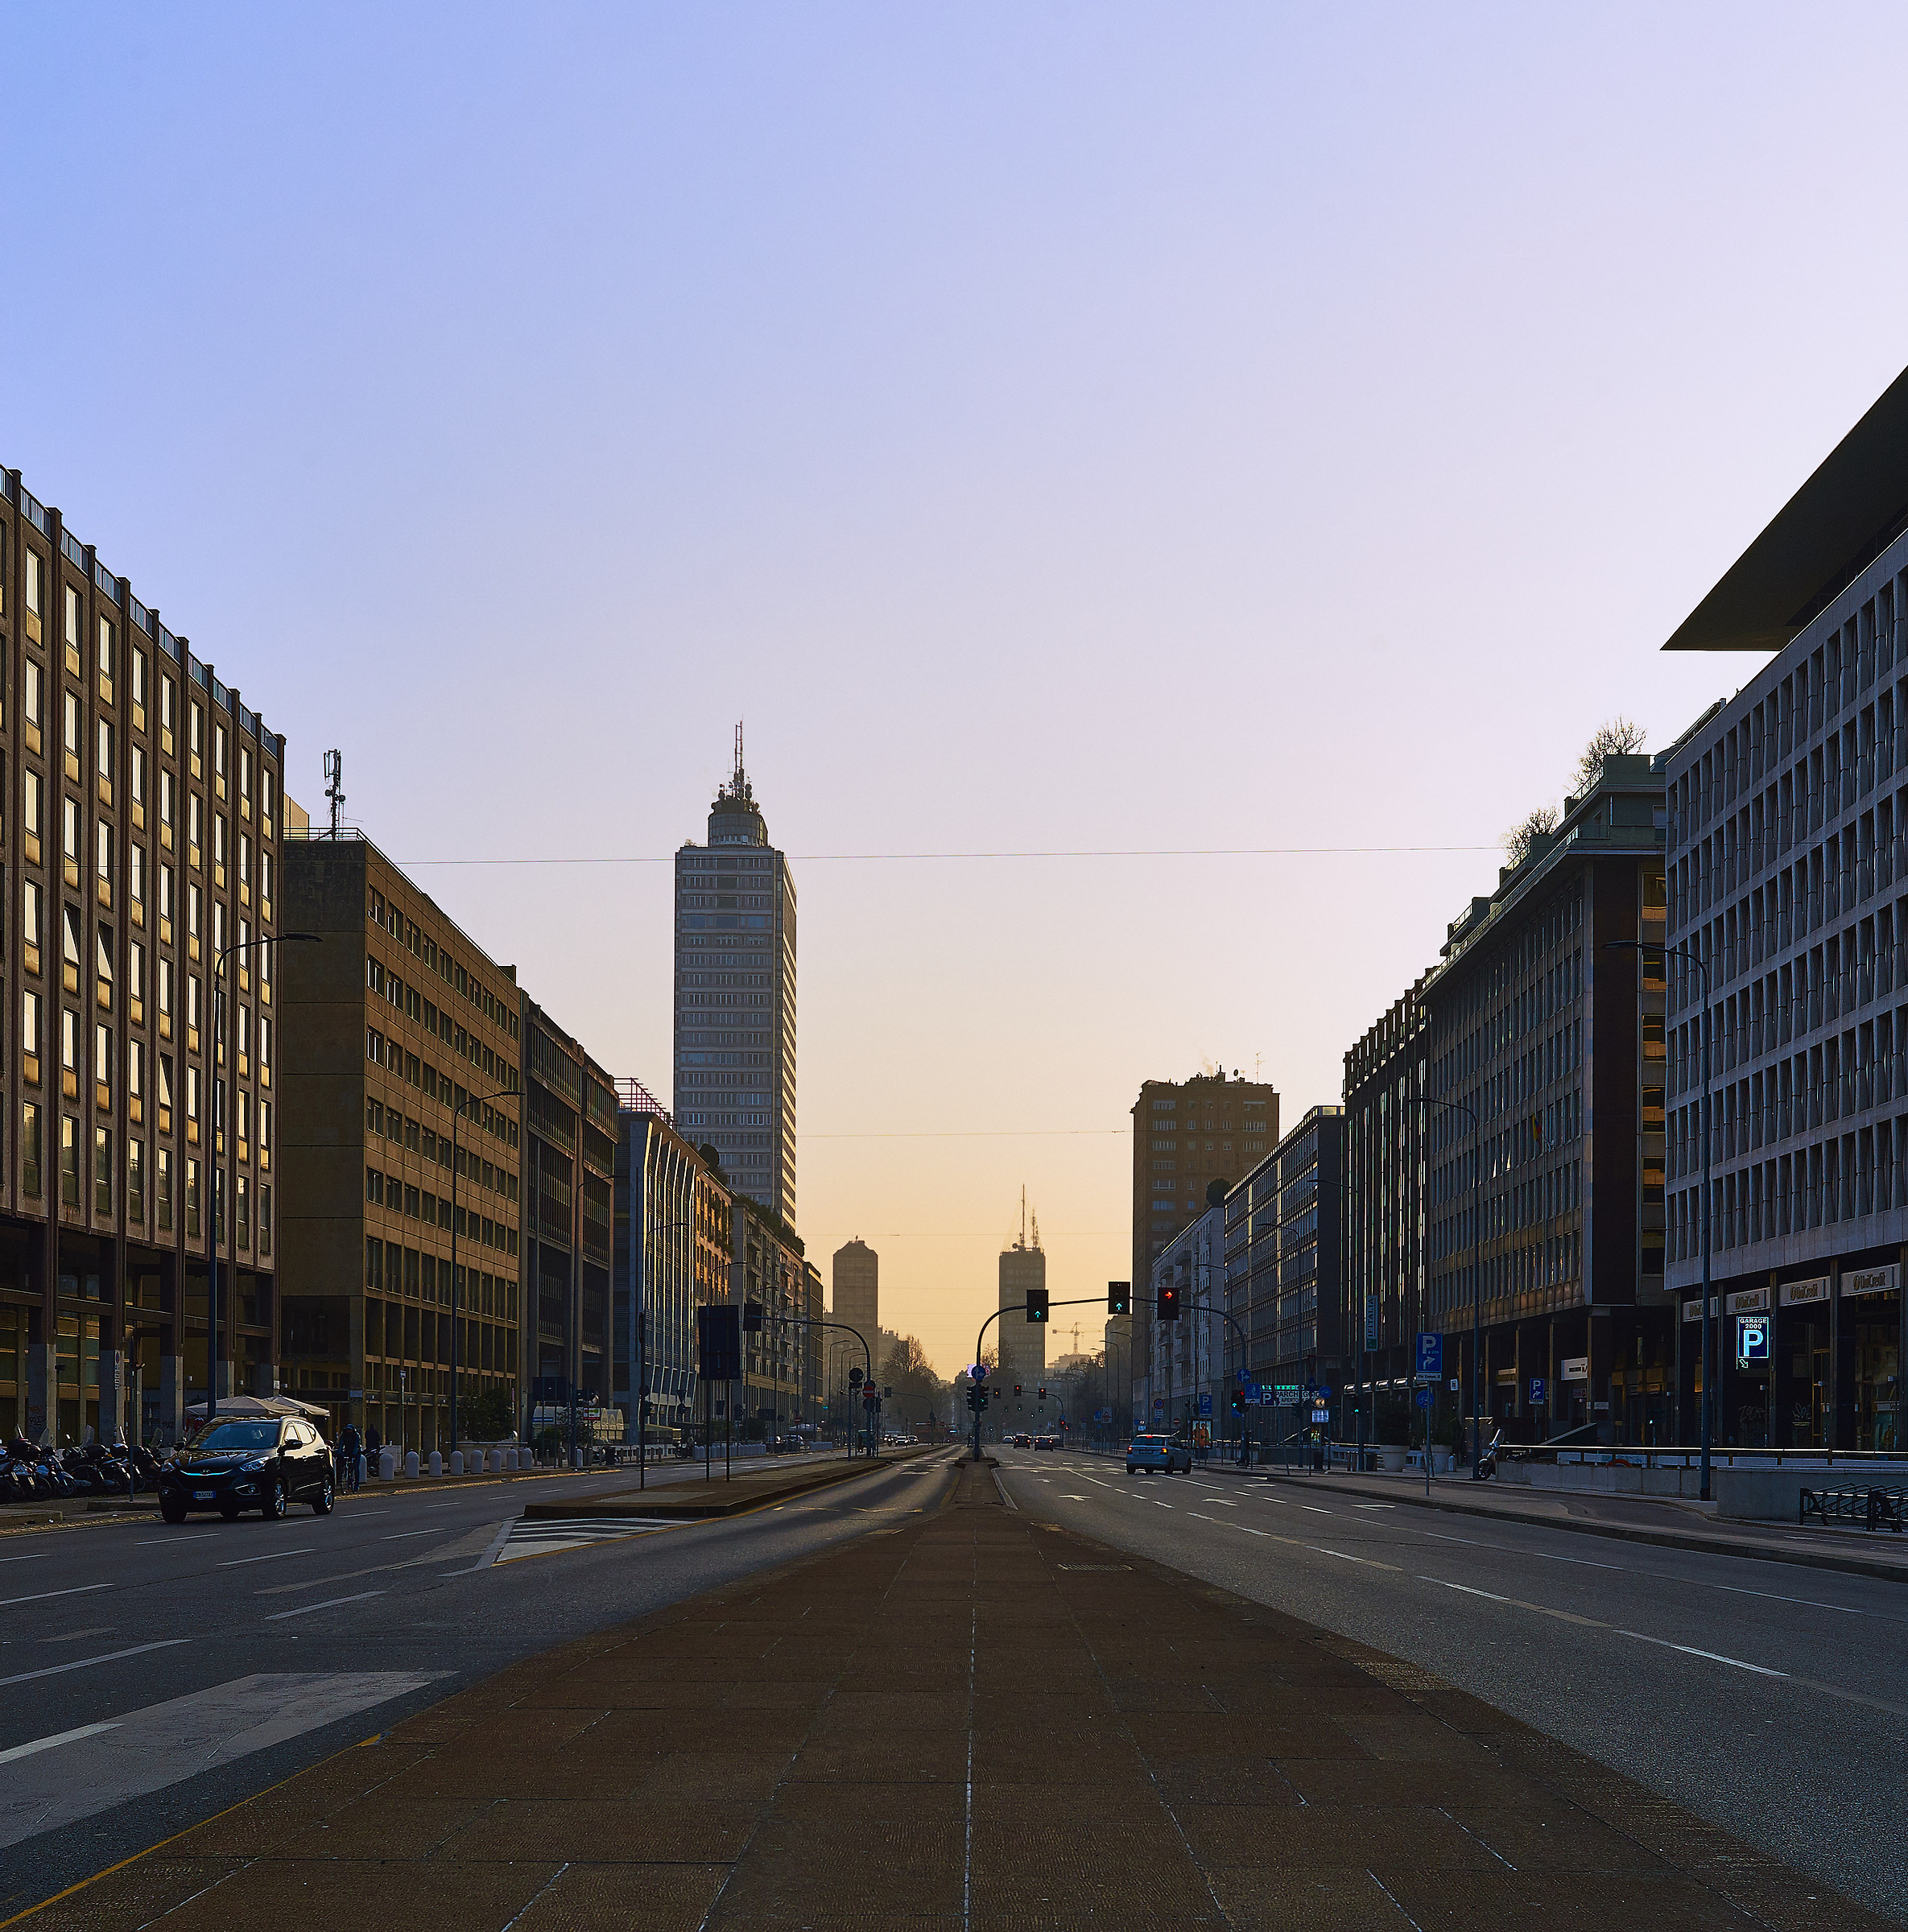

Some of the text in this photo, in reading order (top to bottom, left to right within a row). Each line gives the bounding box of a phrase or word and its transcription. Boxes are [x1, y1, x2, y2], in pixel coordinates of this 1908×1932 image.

[1861, 1271, 1885, 1290] UniCredit
[1423, 1335, 1436, 1354] P
[1743, 1330, 1763, 1357] P
[1533, 1380, 1541, 1390] P
[1202, 1397, 1209, 1406] P
[1262, 1393, 1272, 1405] P
